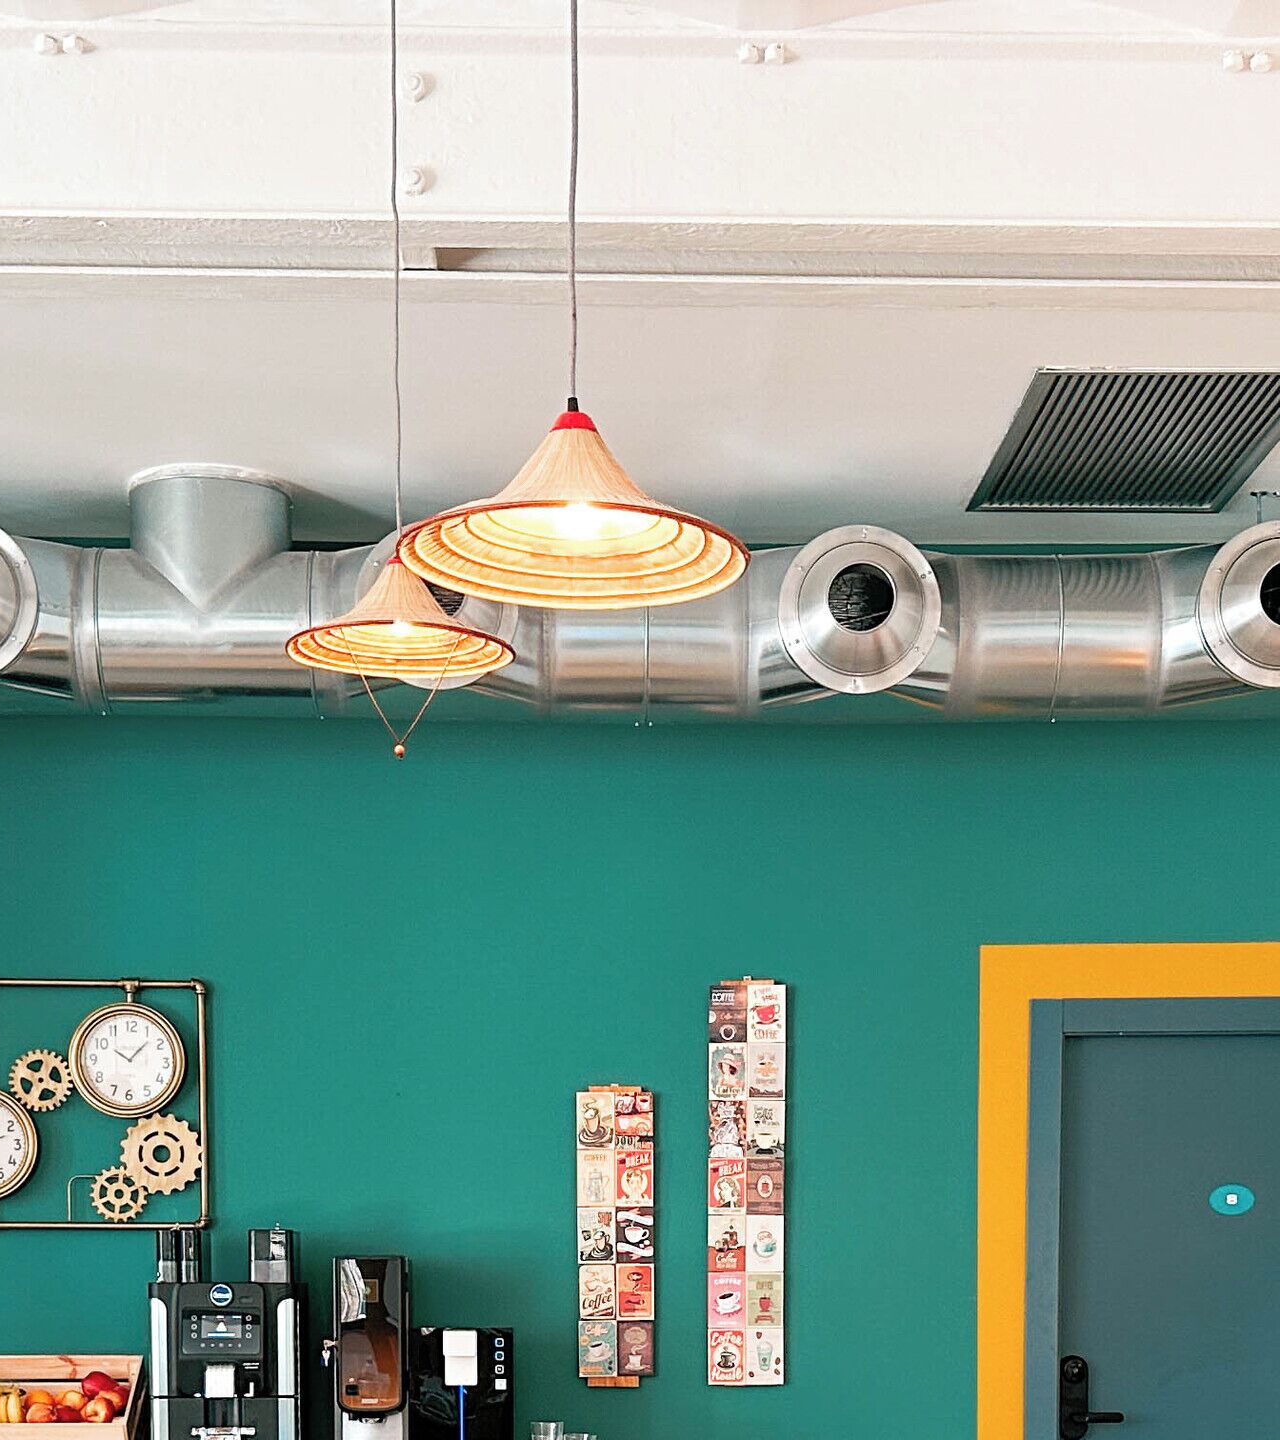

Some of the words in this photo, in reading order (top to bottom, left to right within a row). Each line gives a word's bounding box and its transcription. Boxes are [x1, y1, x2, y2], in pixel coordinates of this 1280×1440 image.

[109, 1025, 117, 1037] 11
[126, 1021, 138, 1032] 12
[95, 1038, 109, 1050] 10
[157, 1039, 164, 1050] 2
[89, 1054, 97, 1065] 9
[163, 1057, 170, 1069] 3
[95, 1071, 103, 1083] 8
[156, 1073, 164, 1084] 4
[111, 1085, 118, 1096] 7
[125, 1089, 133, 1101] 6
[143, 1085, 151, 1097] 5
[7, 1120, 15, 1132] 2
[14, 1139, 22, 1151] 3
[8, 1155, 17, 1166] 4
[625, 1153, 651, 1168] BREAK
[582, 1293, 613, 1310] Coffee
[711, 1331, 743, 1347] Coffee
